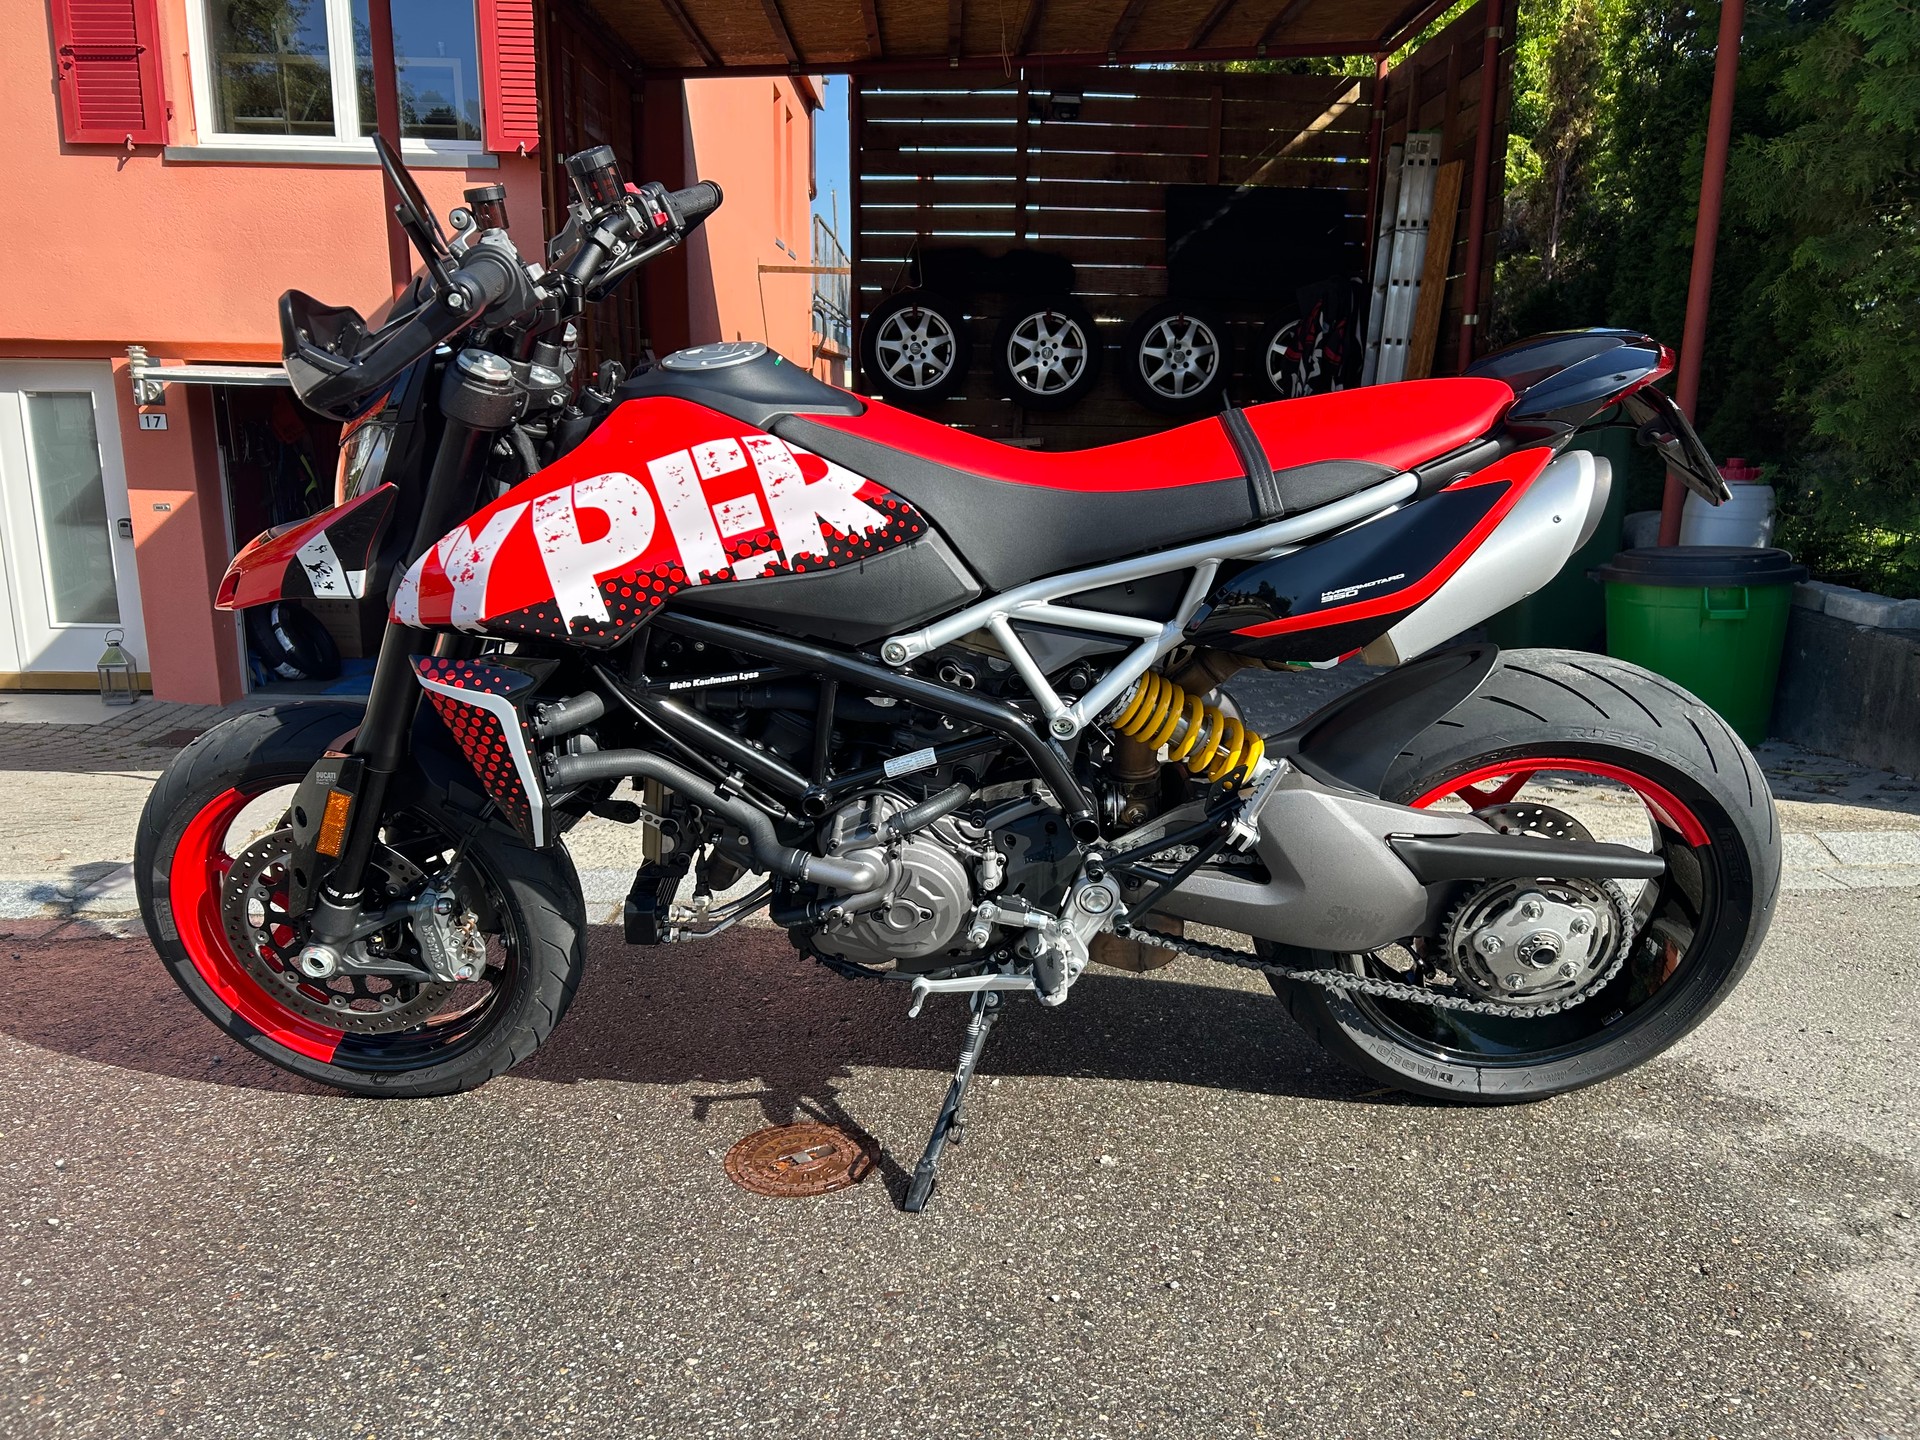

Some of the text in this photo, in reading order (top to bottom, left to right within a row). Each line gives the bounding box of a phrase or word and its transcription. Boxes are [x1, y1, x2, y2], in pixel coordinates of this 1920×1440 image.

[144, 415, 162, 429] 17
[1321, 573, 1405, 597] HYPERMOTARD
[1321, 589, 1358, 603] 950
[669, 671, 760, 690] Moto Kaufmann Lyss
[1566, 726, 1659, 753] ROSSO
[315, 771, 337, 780] DUCATI
[421, 924, 445, 970] brembo
[1375, 1044, 1455, 1085] DIABLO
